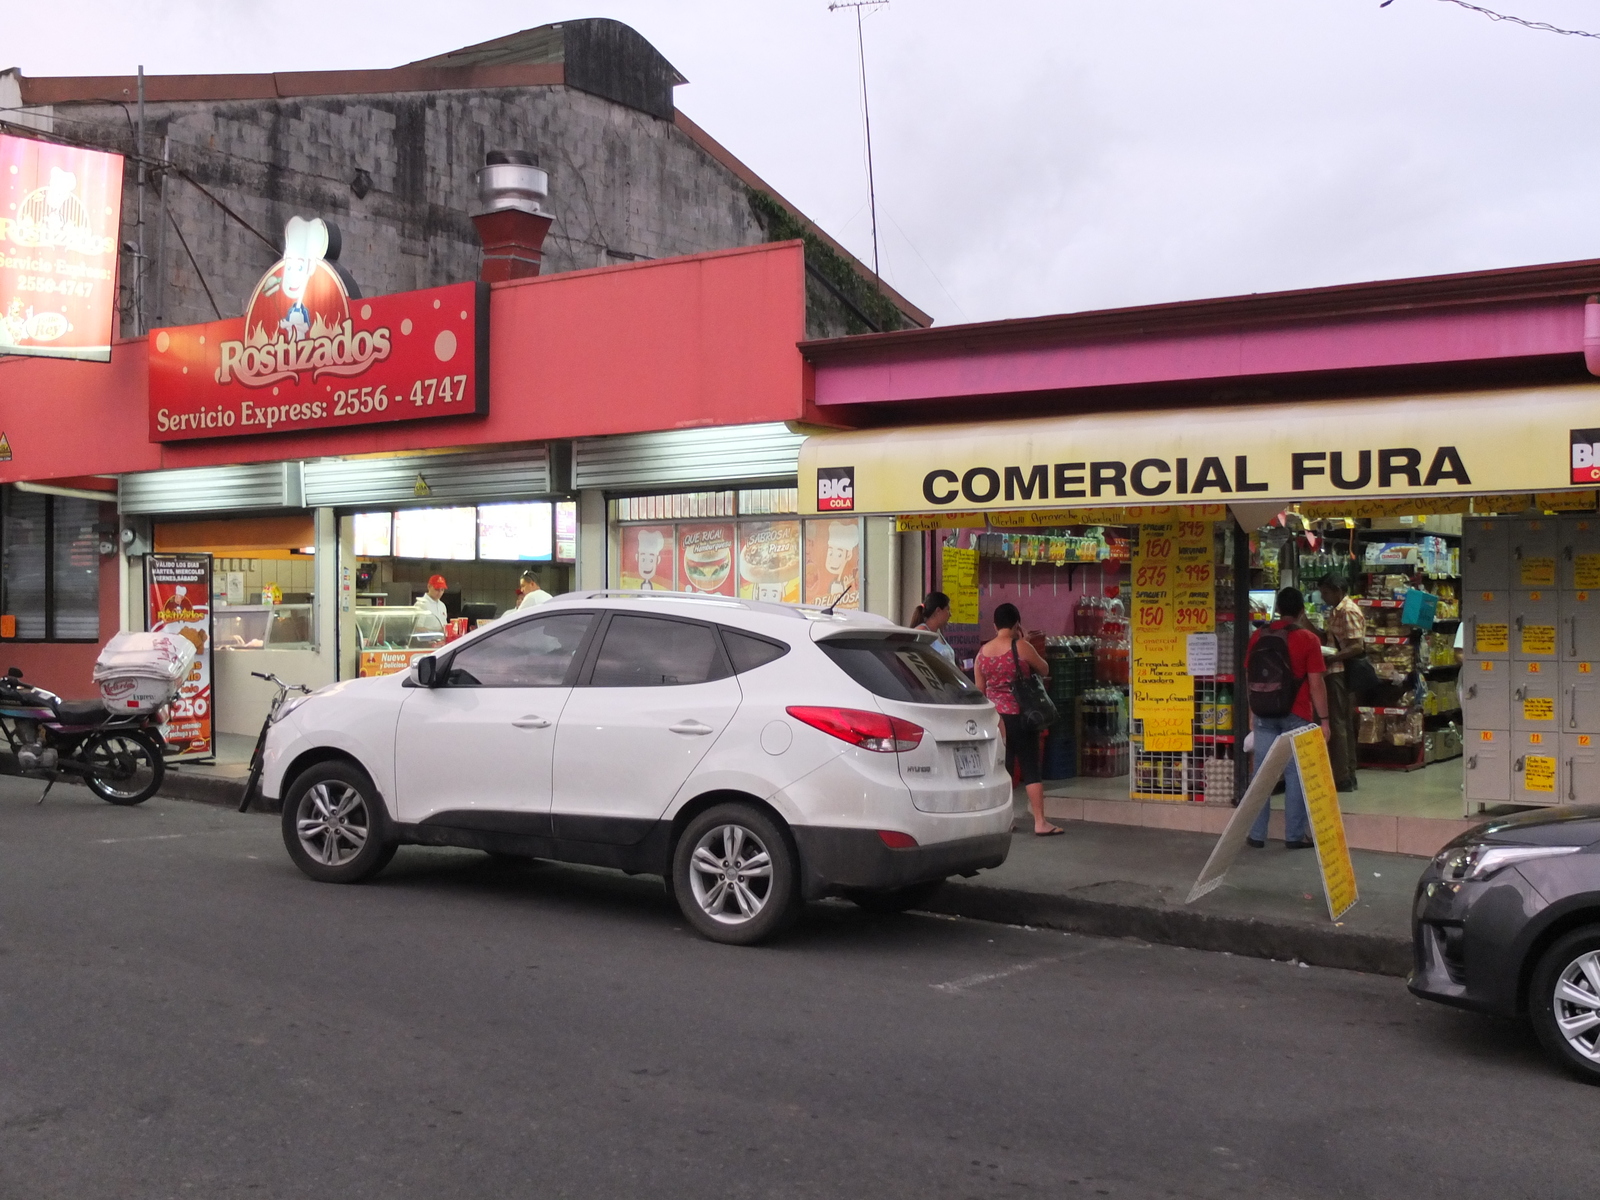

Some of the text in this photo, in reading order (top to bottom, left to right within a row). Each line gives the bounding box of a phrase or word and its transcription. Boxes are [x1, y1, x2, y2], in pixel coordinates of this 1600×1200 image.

[218, 327, 391, 386] Rostizados
[157, 405, 235, 432] Servicio
[241, 400, 328, 428] Express:
[333, 385, 389, 416] 2556
[409, 374, 468, 406] 4747
[1572, 442, 1600, 468] BI
[922, 446, 1472, 505] COMERCIAL FURA
[818, 477, 853, 500] BIG
[829, 498, 852, 509] COLA
[1145, 538, 1171, 558] 150
[1136, 565, 1168, 587] 875
[1184, 564, 1210, 582] 995
[1139, 606, 1164, 626] 150
[1176, 607, 1208, 625] 3990
[1135, 635, 1178, 645] Comercial
[381, 653, 406, 662] Nuevo
